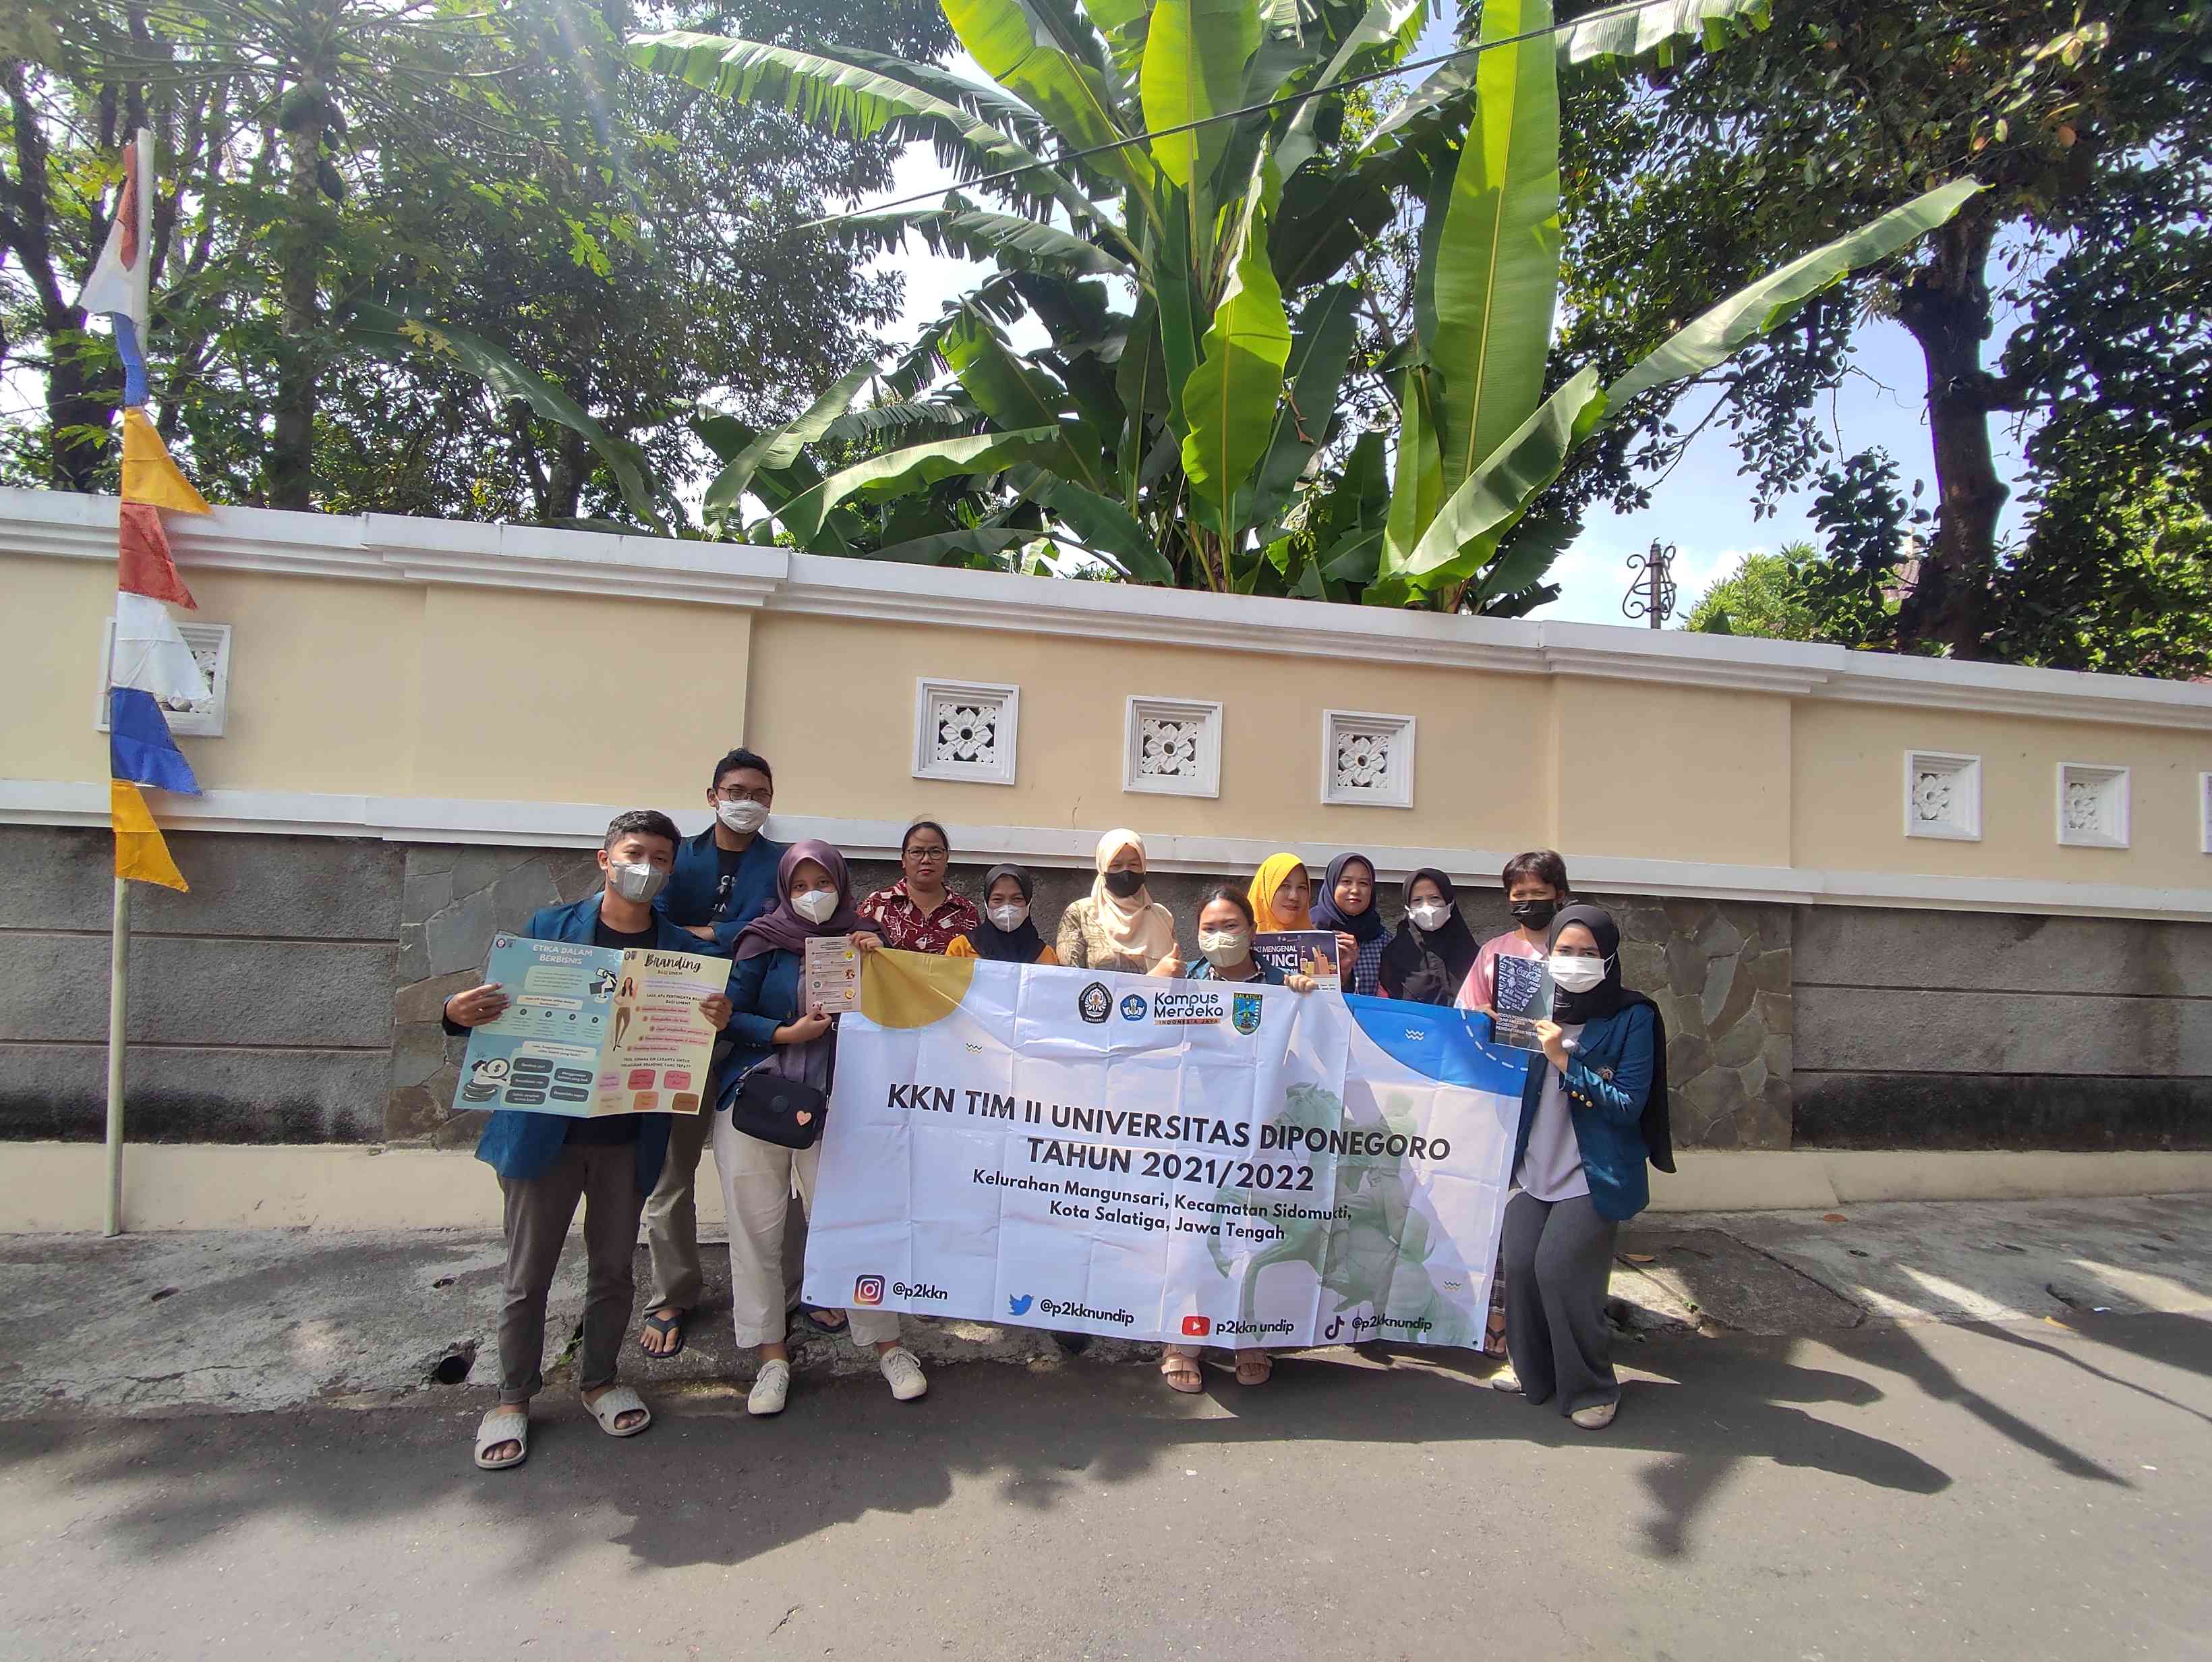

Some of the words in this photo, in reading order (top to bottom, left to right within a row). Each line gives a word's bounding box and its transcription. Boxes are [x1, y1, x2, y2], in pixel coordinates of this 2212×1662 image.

[533, 944, 559, 952] ETIKA
[560, 947, 593, 956] DALAM
[540, 954, 583, 965] BERBISNIS
[644, 953, 701, 973] Branding
[1263, 954, 1298, 967] UNCI
[1155, 992, 1219, 1007] Kampus
[1154, 1005, 1223, 1018] Merdeka
[887, 1083, 955, 1112] KKN
[965, 1090, 1015, 1120] TIM
[1024, 1100, 1041, 1124] II
[1051, 1105, 1250, 1147] UNIVERSITAS
[1260, 1124, 1451, 1161] DIPONEGORO
[1027, 1137, 1131, 1174] TAHUN
[1141, 1151, 1314, 1191] 2021/2022
[973, 1168, 1059, 1193] Kelurahan
[1064, 1180, 1169, 1209] Mangunsari,
[1174, 1193, 1268, 1217] Kecamatan
[1273, 1203, 1351, 1221] Sidomukti,
[1049, 1200, 1090, 1219] Kota
[1095, 1206, 1170, 1232] Salatiga,
[1175, 1217, 1221, 1236] Jawa
[1226, 1222, 1285, 1243] Tengah
[892, 1282, 948, 1300] @p2kkn
[1040, 1299, 1134, 1327] @p2kknundip
[1216, 1319, 1257, 1336] p2kkn
[1260, 1319, 1294, 1336] undip
